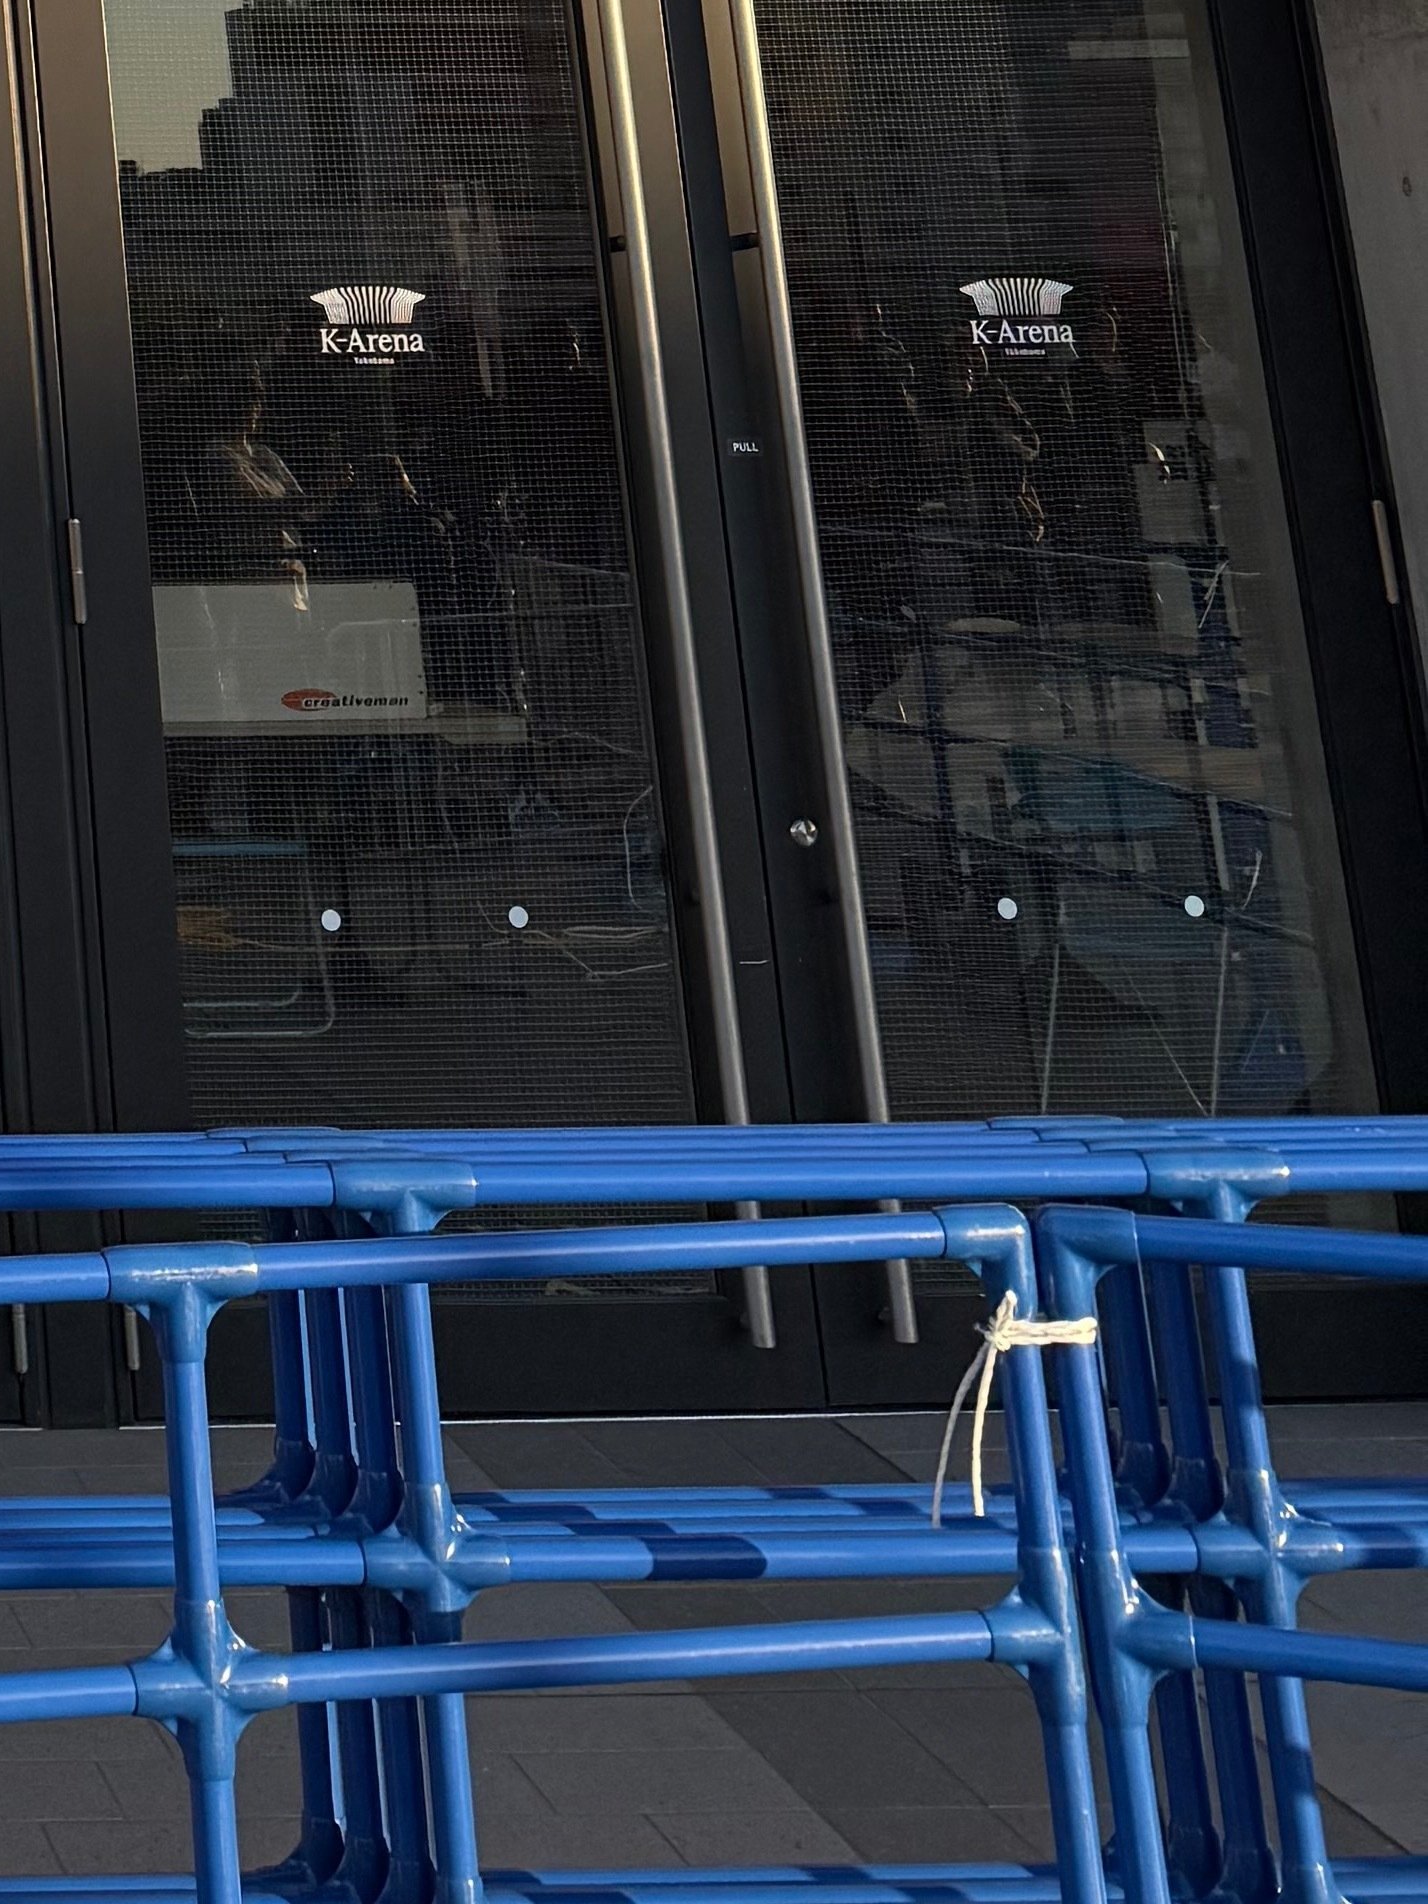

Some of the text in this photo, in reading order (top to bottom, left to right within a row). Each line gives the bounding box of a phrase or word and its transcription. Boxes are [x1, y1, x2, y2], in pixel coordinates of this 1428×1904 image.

[319, 328, 426, 353] K-Arena
[970, 319, 1076, 345] K-Arena
[732, 442, 760, 453] PULL
